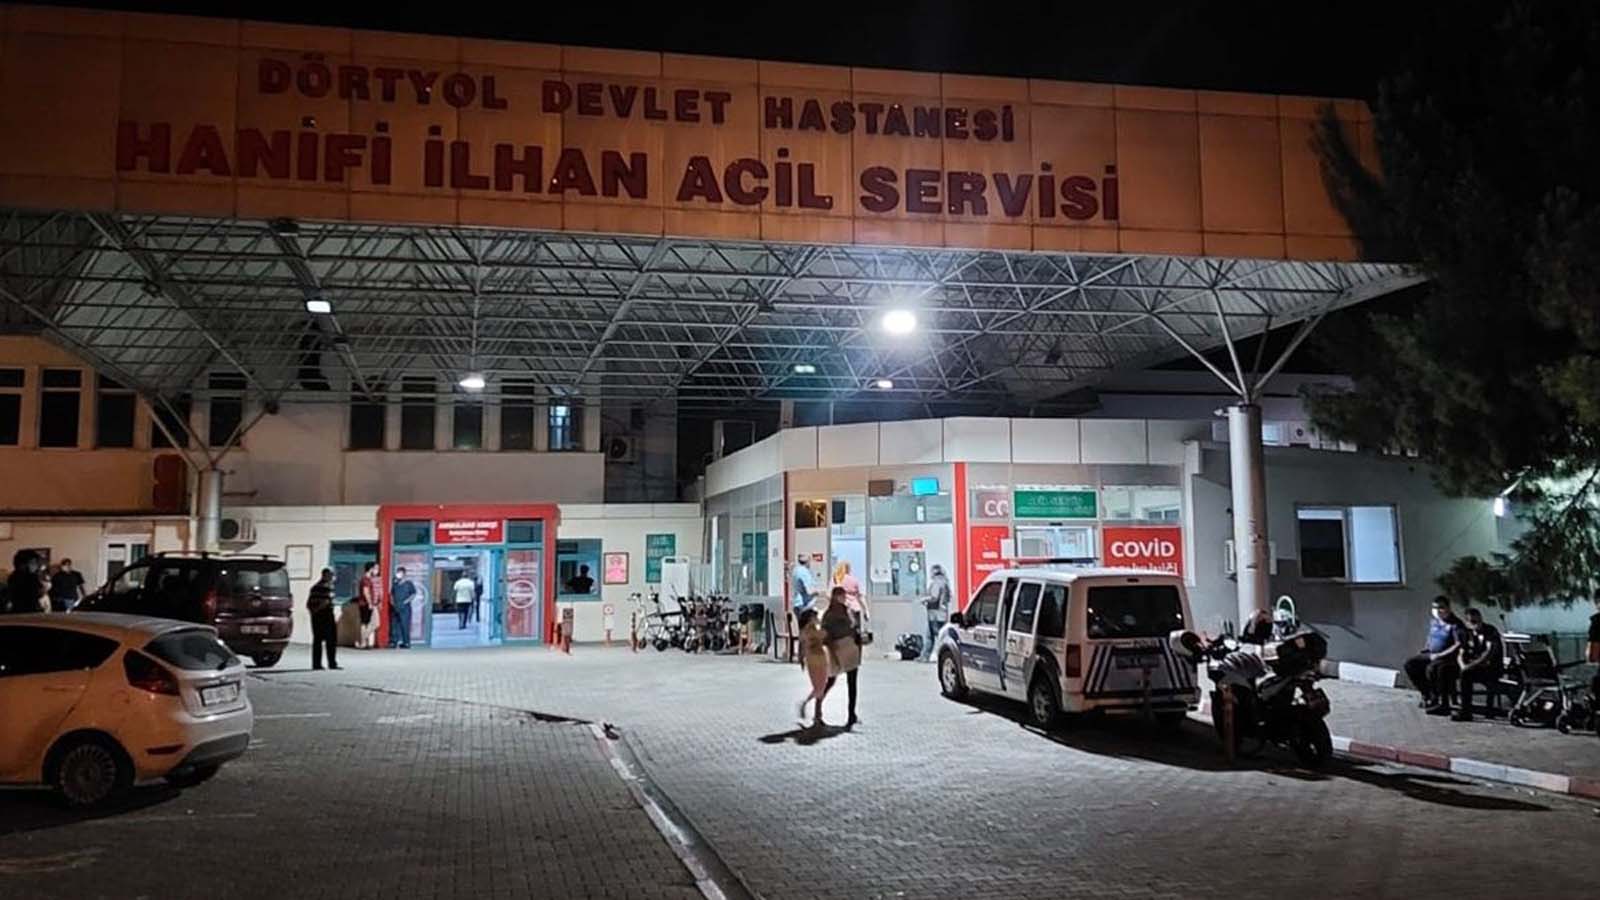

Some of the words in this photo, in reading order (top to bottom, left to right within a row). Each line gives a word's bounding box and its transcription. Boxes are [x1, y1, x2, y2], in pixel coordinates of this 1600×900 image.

[258, 52, 508, 110] DÖRTYOL
[542, 79, 731, 125] DEVLET
[764, 96, 1015, 143] HASTANESİ
[116, 116, 392, 186] HANİFİ
[424, 125, 648, 199] İLHAN
[676, 148, 833, 210] ACİL
[859, 162, 1120, 222] SERVİSİ
[1111, 537, 1175, 558] COVİD
